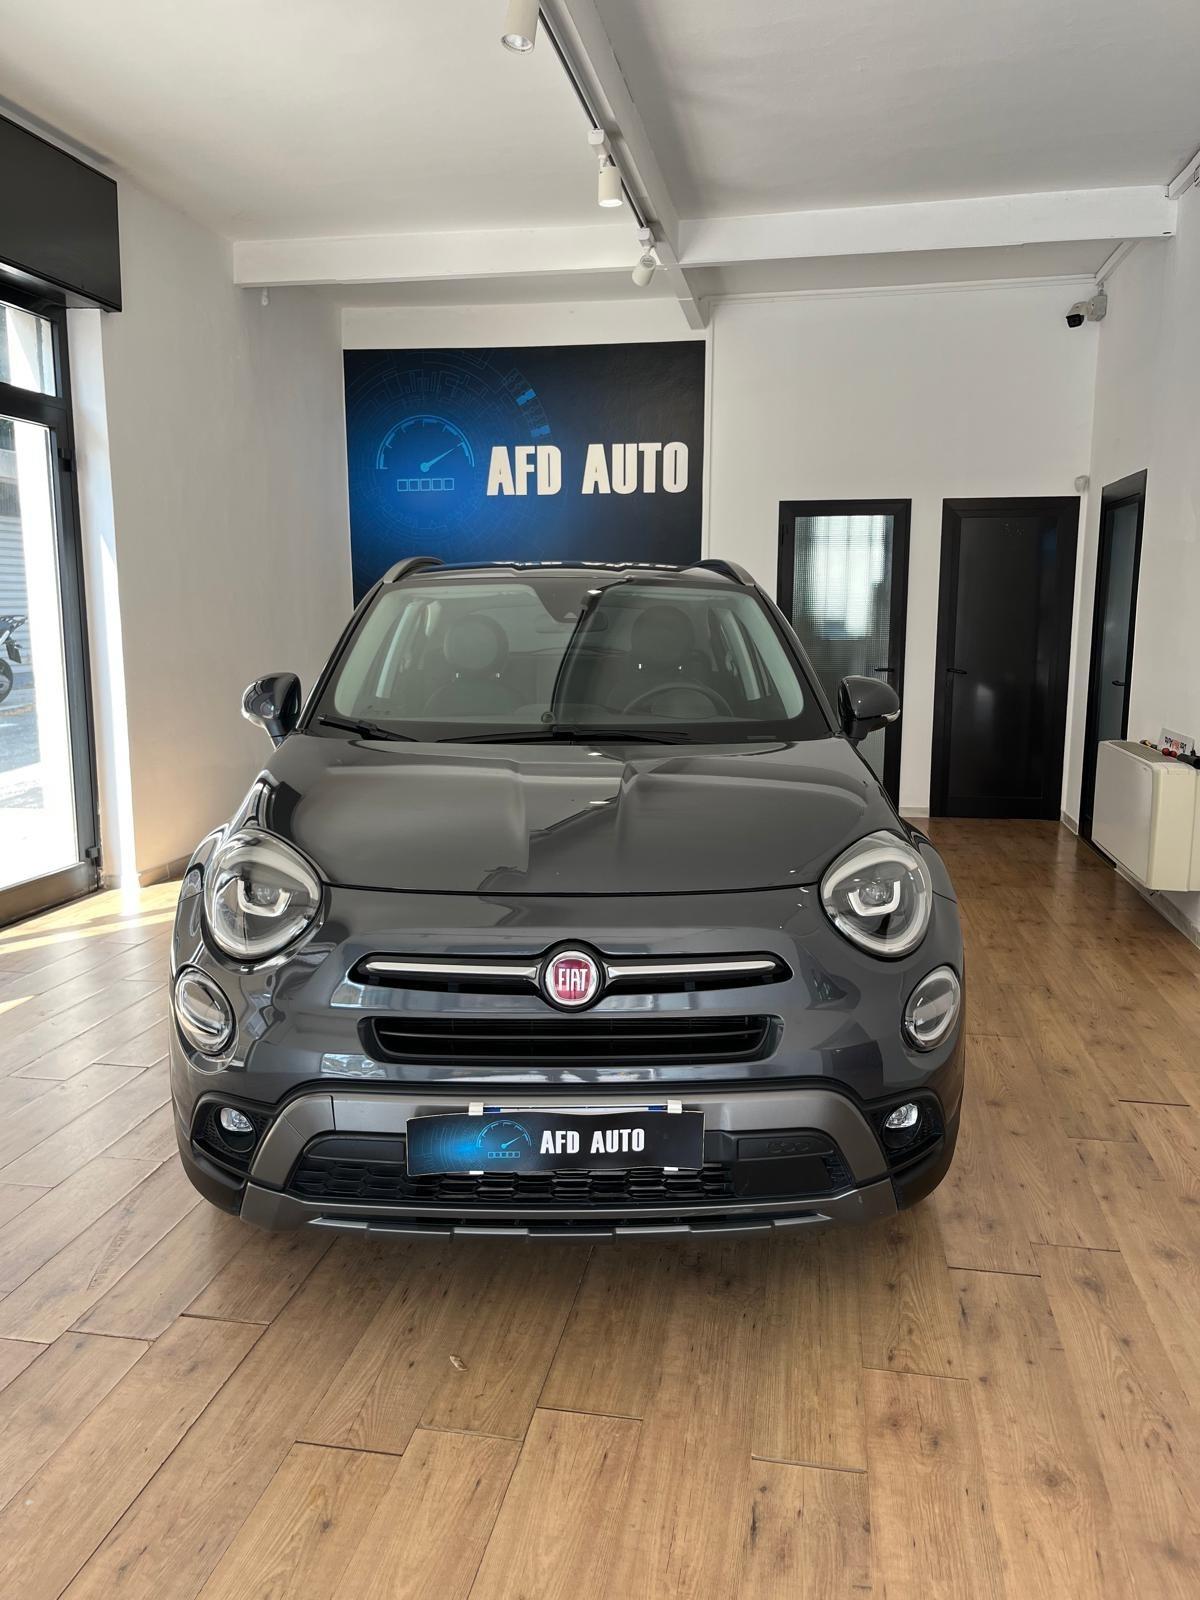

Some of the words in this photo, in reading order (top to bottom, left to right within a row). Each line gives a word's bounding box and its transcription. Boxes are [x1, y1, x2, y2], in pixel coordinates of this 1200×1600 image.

[486, 445, 562, 496] AFD
[581, 441, 689, 495] AUTO
[558, 967, 588, 992] FIAT
[539, 1130, 580, 1154] AFD
[590, 1128, 645, 1153] AUTO
